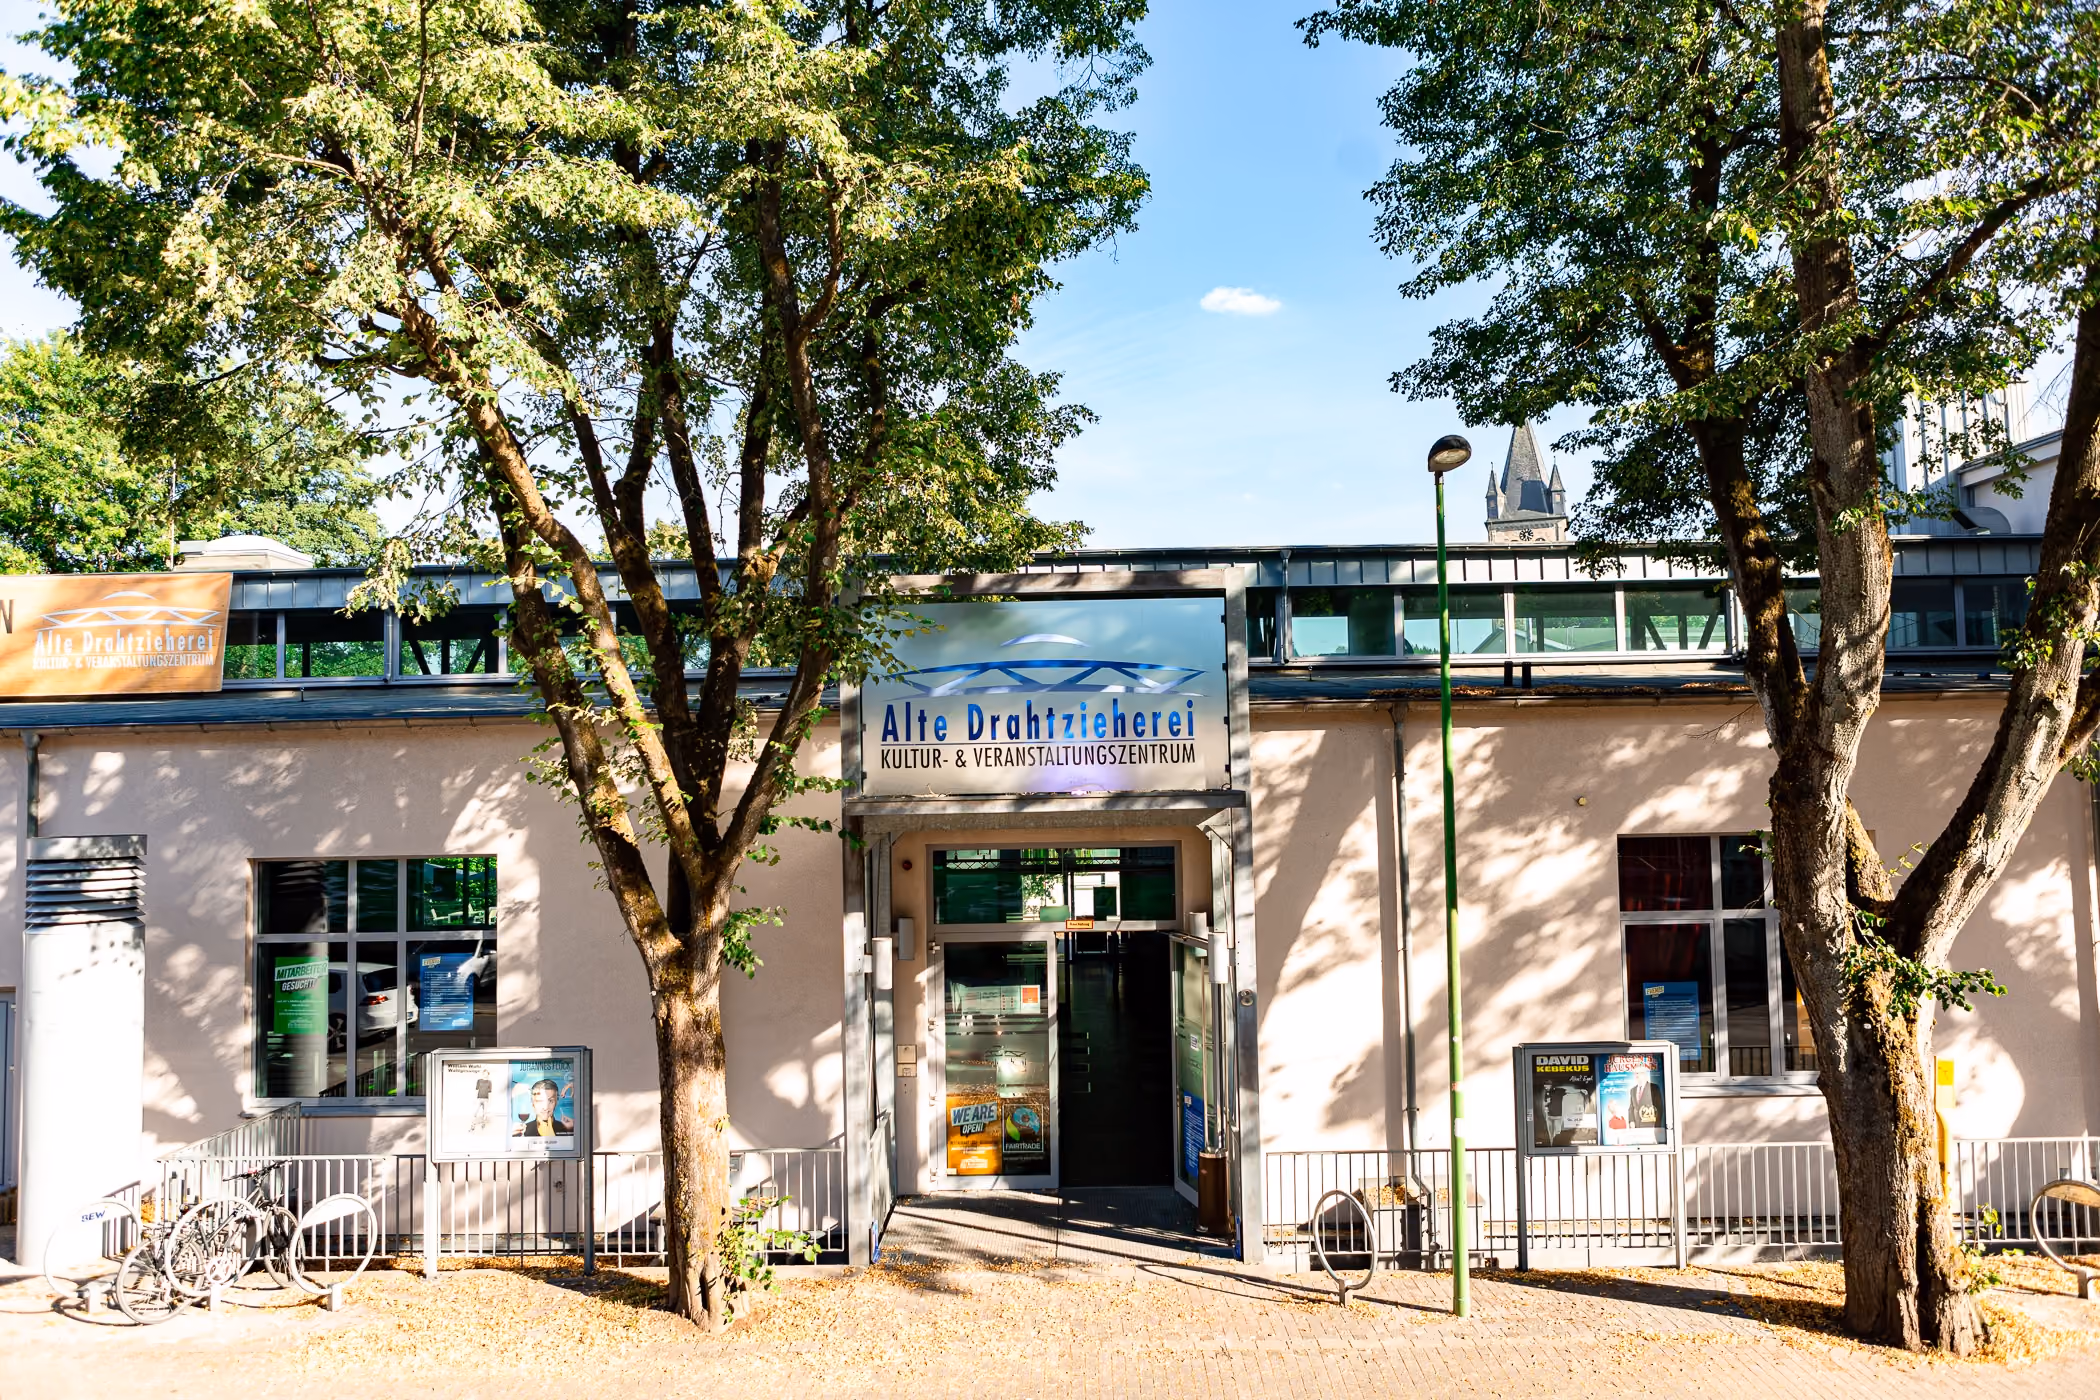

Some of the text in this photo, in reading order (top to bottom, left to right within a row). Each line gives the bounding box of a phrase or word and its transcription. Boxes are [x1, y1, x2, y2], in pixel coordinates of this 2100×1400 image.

[34, 628, 214, 655] Alte Drahtzieherei
[881, 699, 1195, 742] Alte Drahtzieherei
[881, 743, 1196, 769] KULTUR- & VERANSTALTUNGSZENTRUM
[276, 962, 328, 979] MITARBEITER
[1536, 1055, 1589, 1065] DAVID
[953, 1105, 995, 1125] WE ARE
[962, 1122, 984, 1134] OPEN!
[1005, 1142, 1041, 1150] FAIRTRADE
